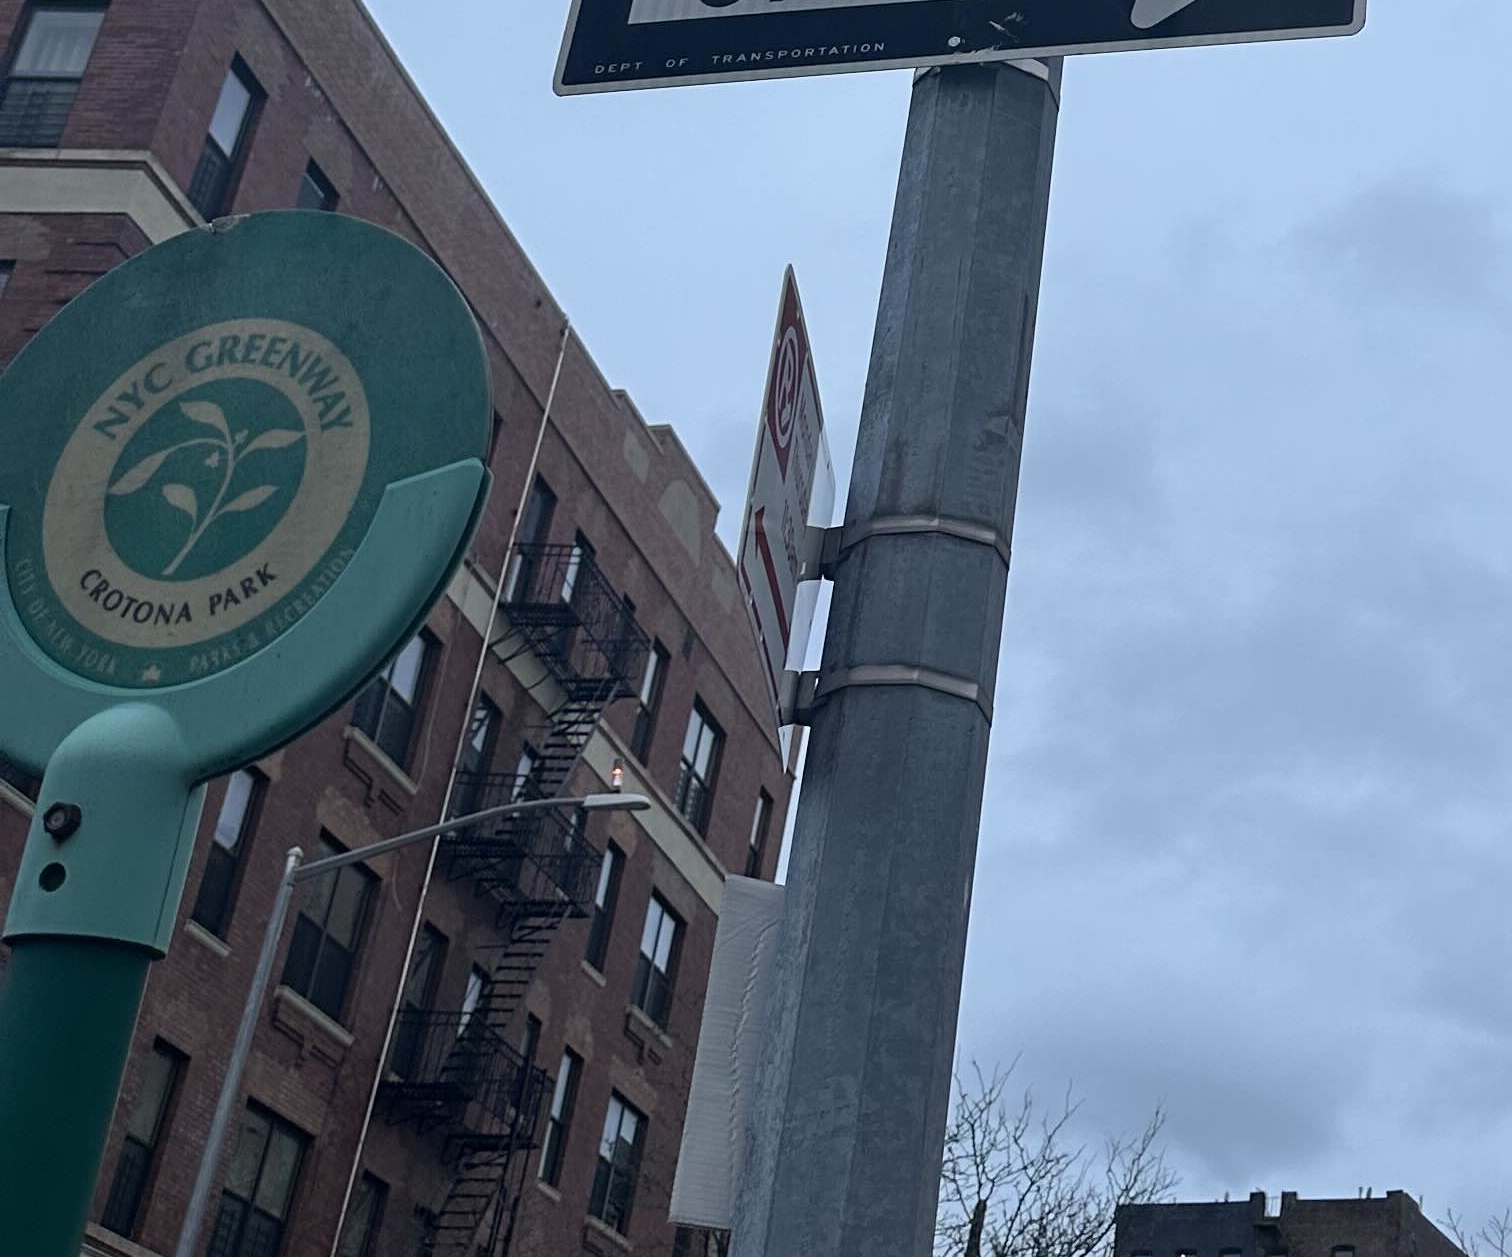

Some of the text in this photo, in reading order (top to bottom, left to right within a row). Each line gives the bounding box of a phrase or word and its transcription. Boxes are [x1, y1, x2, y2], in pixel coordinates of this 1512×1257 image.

[594, 42, 886, 75] DEPT OF TRANSPORTATION
[93, 333, 353, 440] NYC GREENWAY
[80, 562, 278, 626] CROTONA PARK
